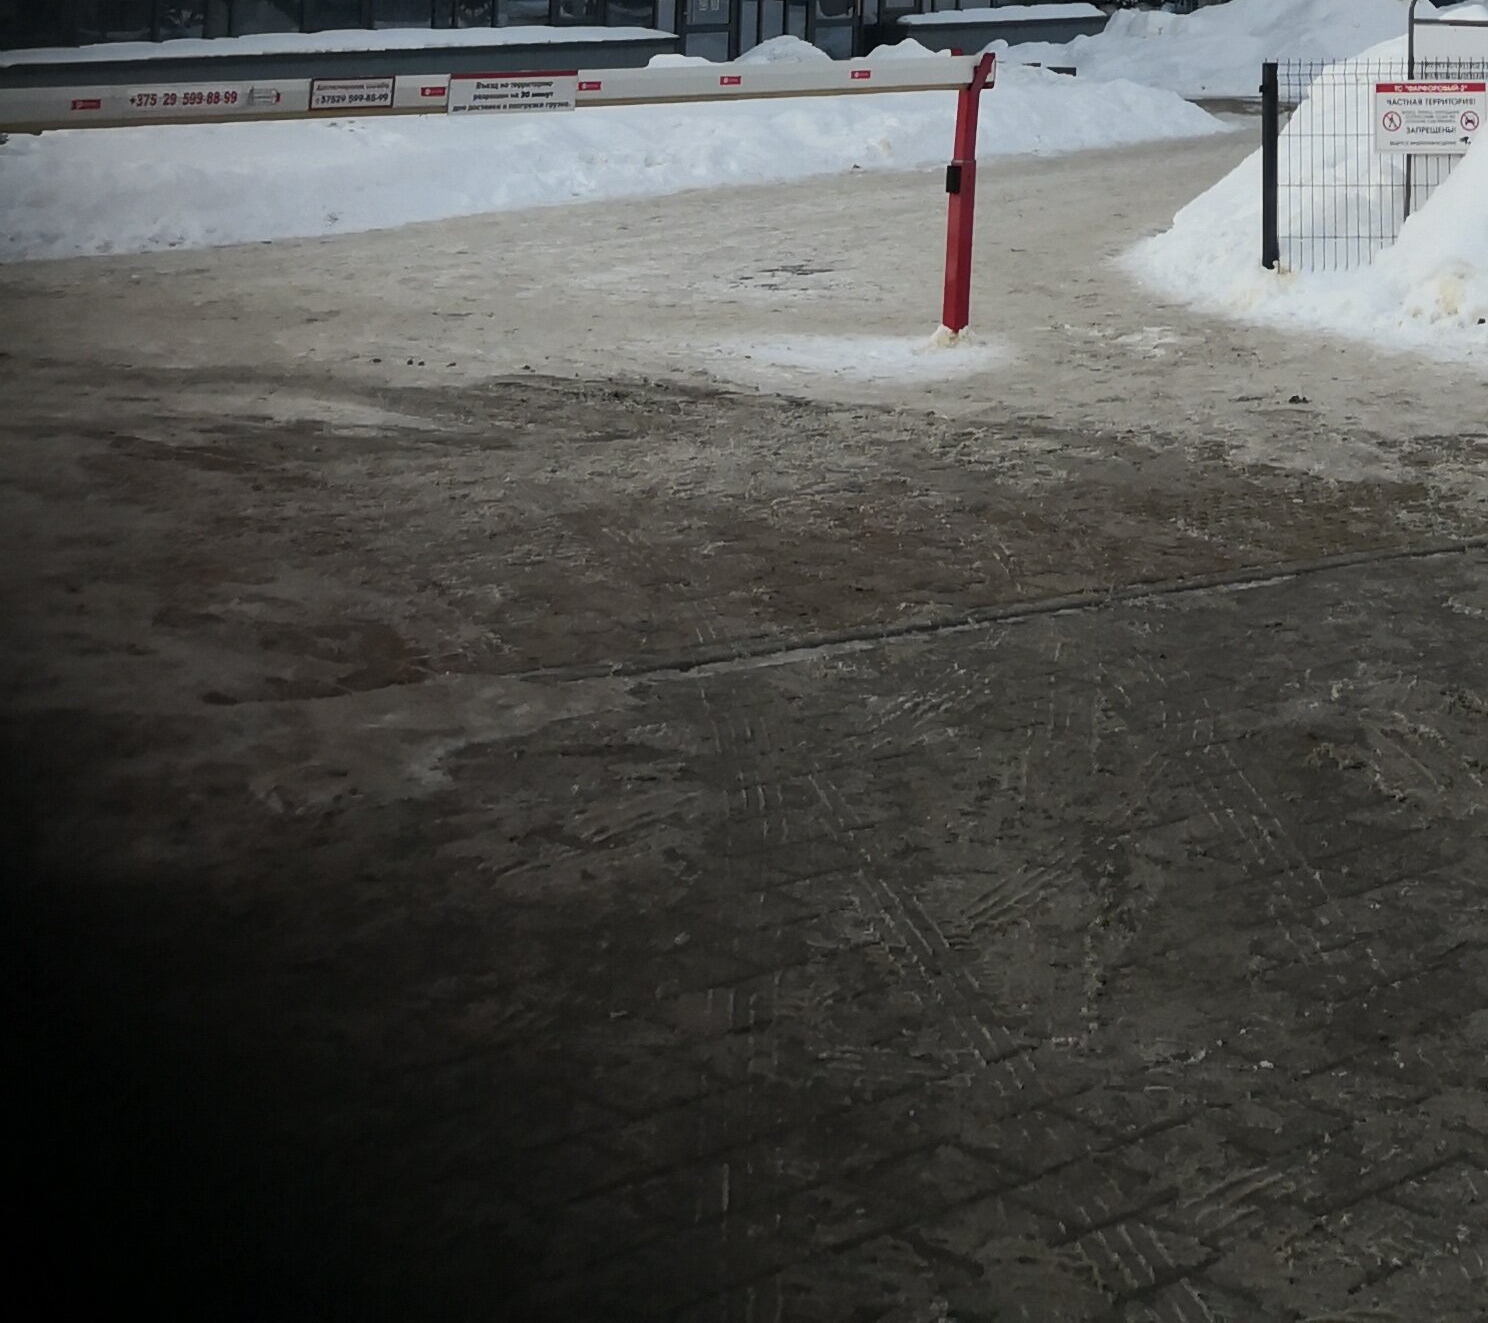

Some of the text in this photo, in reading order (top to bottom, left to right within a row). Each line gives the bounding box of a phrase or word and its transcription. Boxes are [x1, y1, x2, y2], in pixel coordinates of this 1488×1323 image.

[130, 91, 238, 107] +375 29 599-88-99
[1387, 98, 1423, 106] ЧАСТНАЯ
